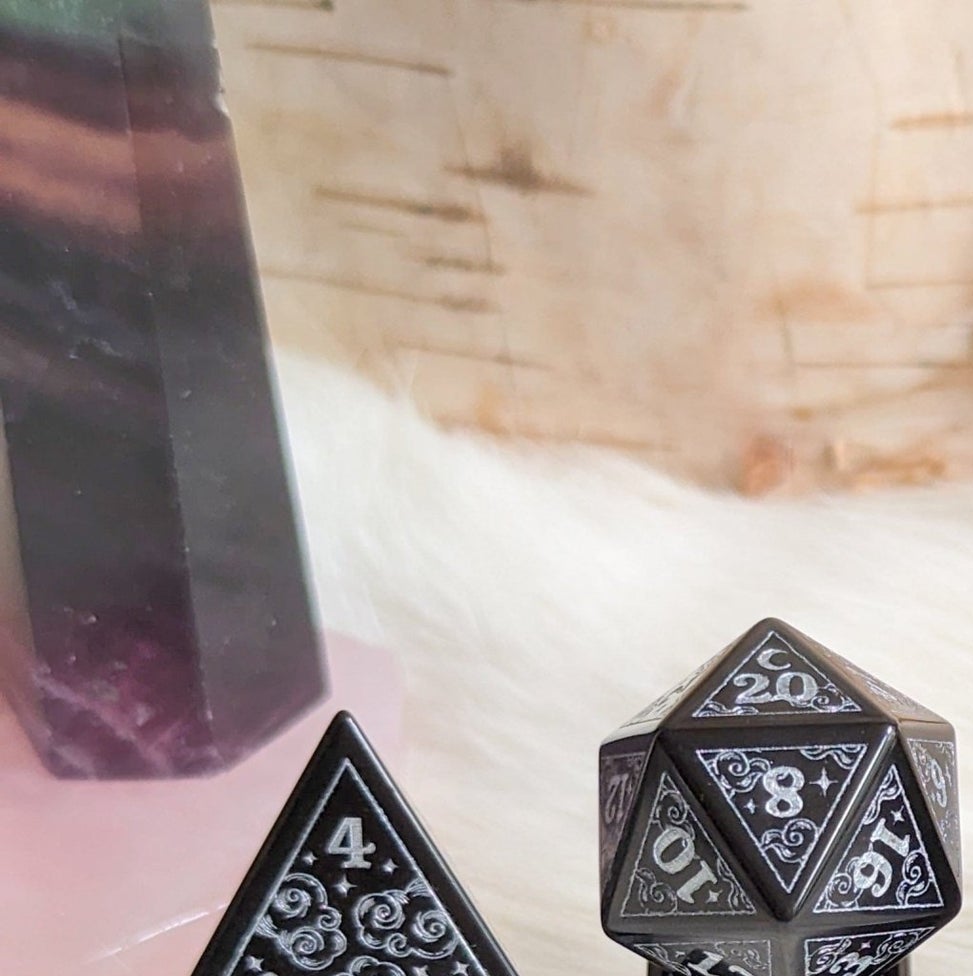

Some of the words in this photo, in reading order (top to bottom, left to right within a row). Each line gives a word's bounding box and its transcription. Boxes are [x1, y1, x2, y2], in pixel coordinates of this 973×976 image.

[733, 671, 820, 707] 20
[762, 765, 805, 819] 8
[327, 816, 376, 870] 4
[652, 823, 719, 904] 10
[852, 817, 911, 899] 16
